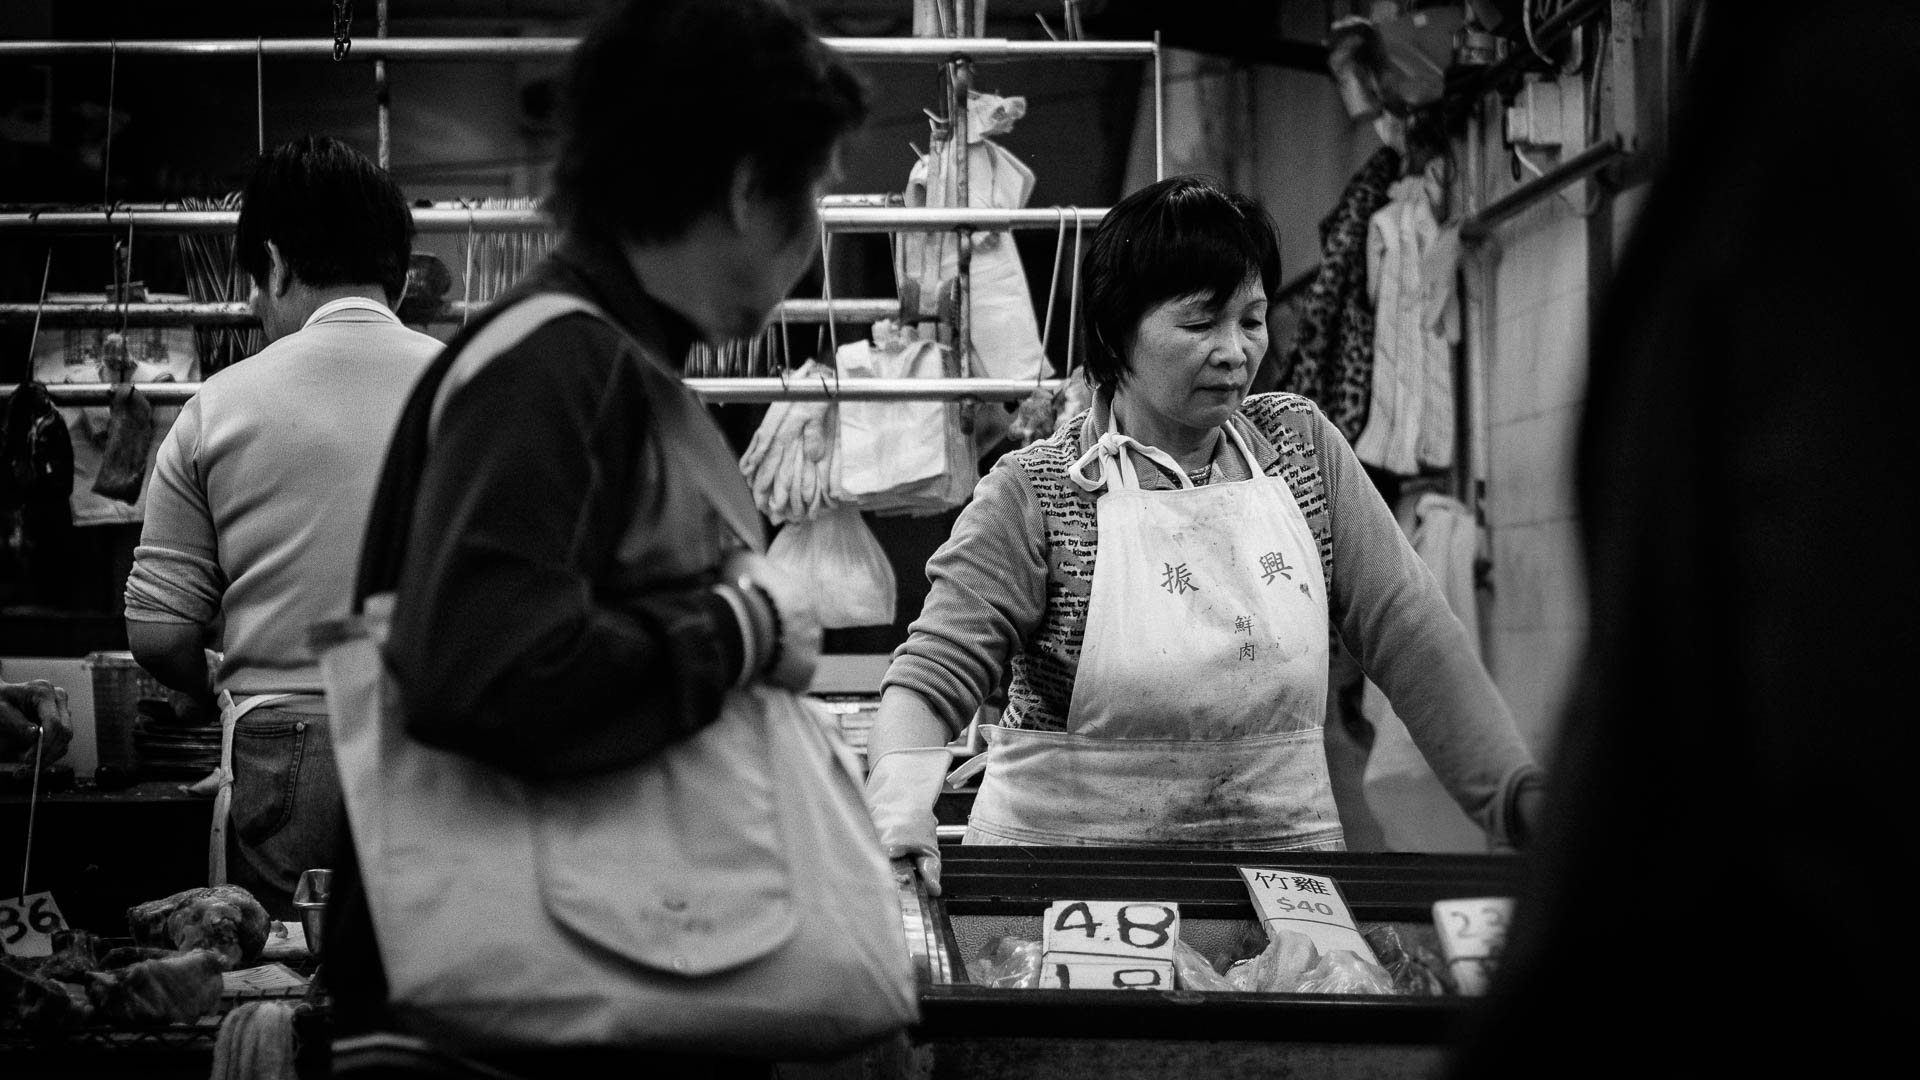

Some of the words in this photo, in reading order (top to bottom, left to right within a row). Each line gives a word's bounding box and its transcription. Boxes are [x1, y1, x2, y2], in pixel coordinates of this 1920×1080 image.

[1289, 469, 1298, 478] by
[1296, 473, 1316, 486] kizea
[1054, 484, 1064, 492] by
[1085, 511, 1095, 519] by
[1068, 539, 1079, 547] by
[1161, 562, 1199, 594] 振
[1259, 551, 1293, 585] 興
[1234, 615, 1255, 661] 鮮肉
[1255, 872, 1331, 896] 竹雞
[1276, 897, 1333, 916] $40
[0, 898, 61, 945] 36
[1054, 901, 1176, 949] 4.8
